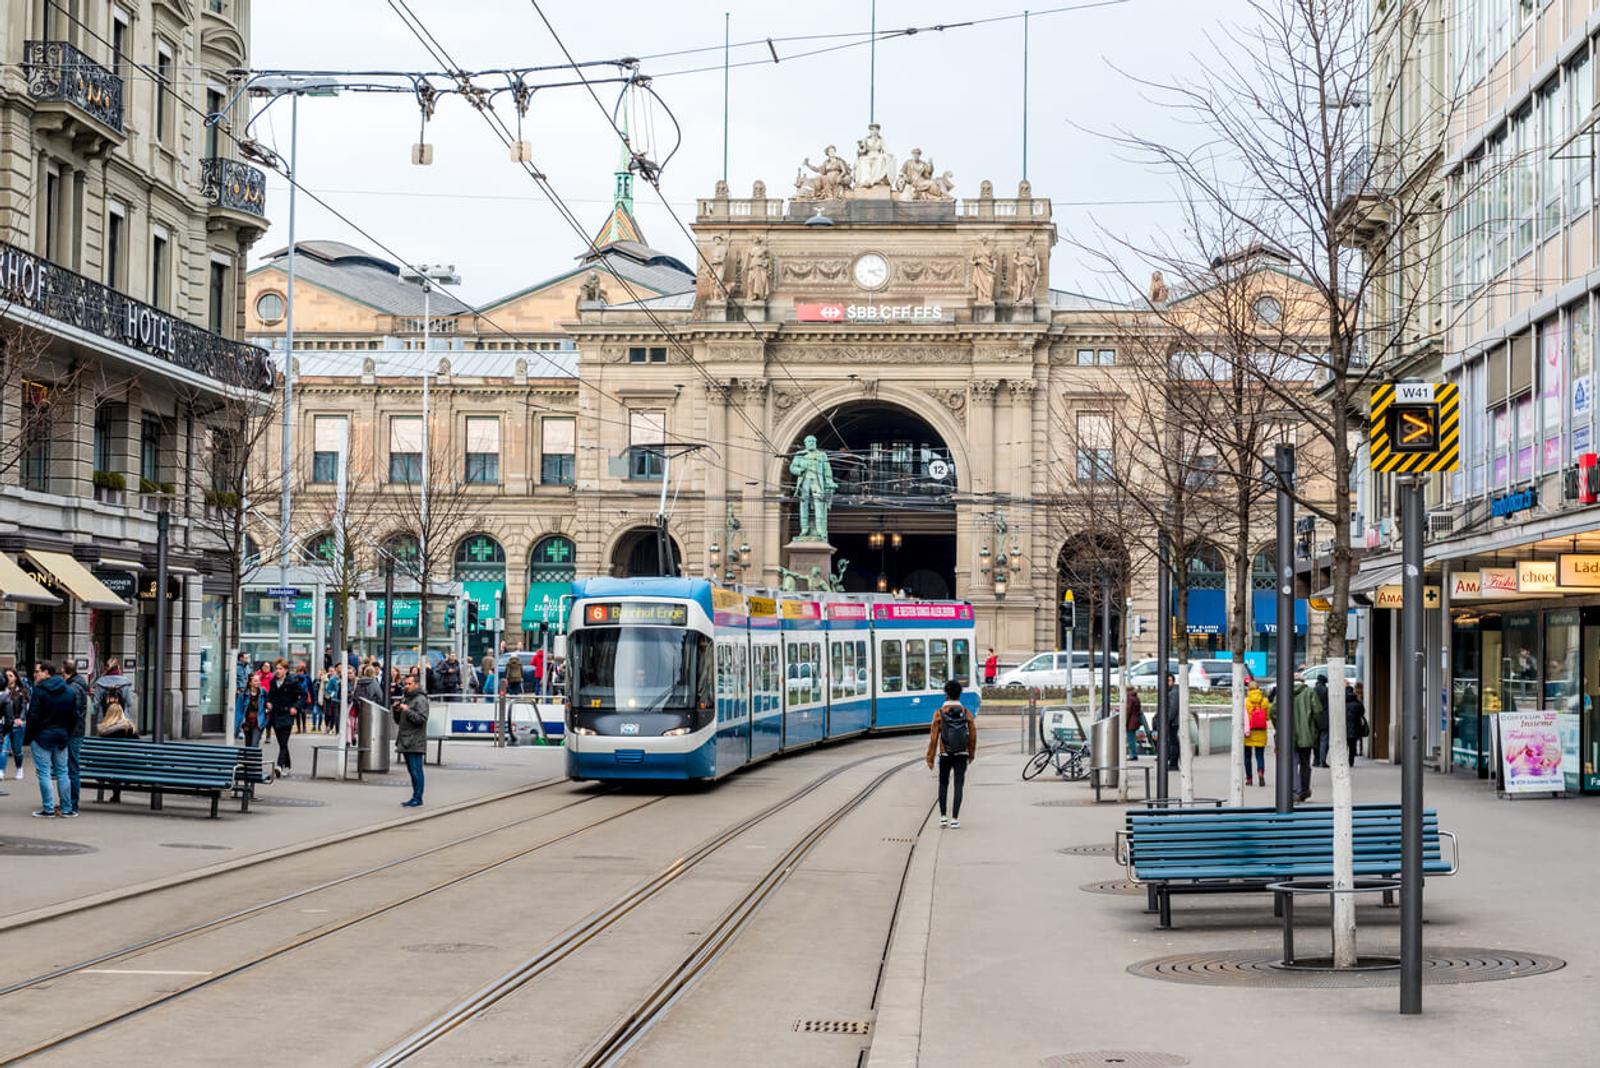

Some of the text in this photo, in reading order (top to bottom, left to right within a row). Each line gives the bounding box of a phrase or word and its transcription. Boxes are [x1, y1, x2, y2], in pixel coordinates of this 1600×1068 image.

[847, 304, 942, 319] SBB CFF FFS
[127, 301, 176, 354] HOTEL
[1403, 387, 1429, 398] W41
[933, 465, 945, 474] 12
[1574, 561, 1600, 573] Läd
[1378, 591, 1403, 604] AMA
[593, 607, 603, 619] 6
[656, 607, 684, 621] Enge
[1590, 777, 1600, 786] Fa
